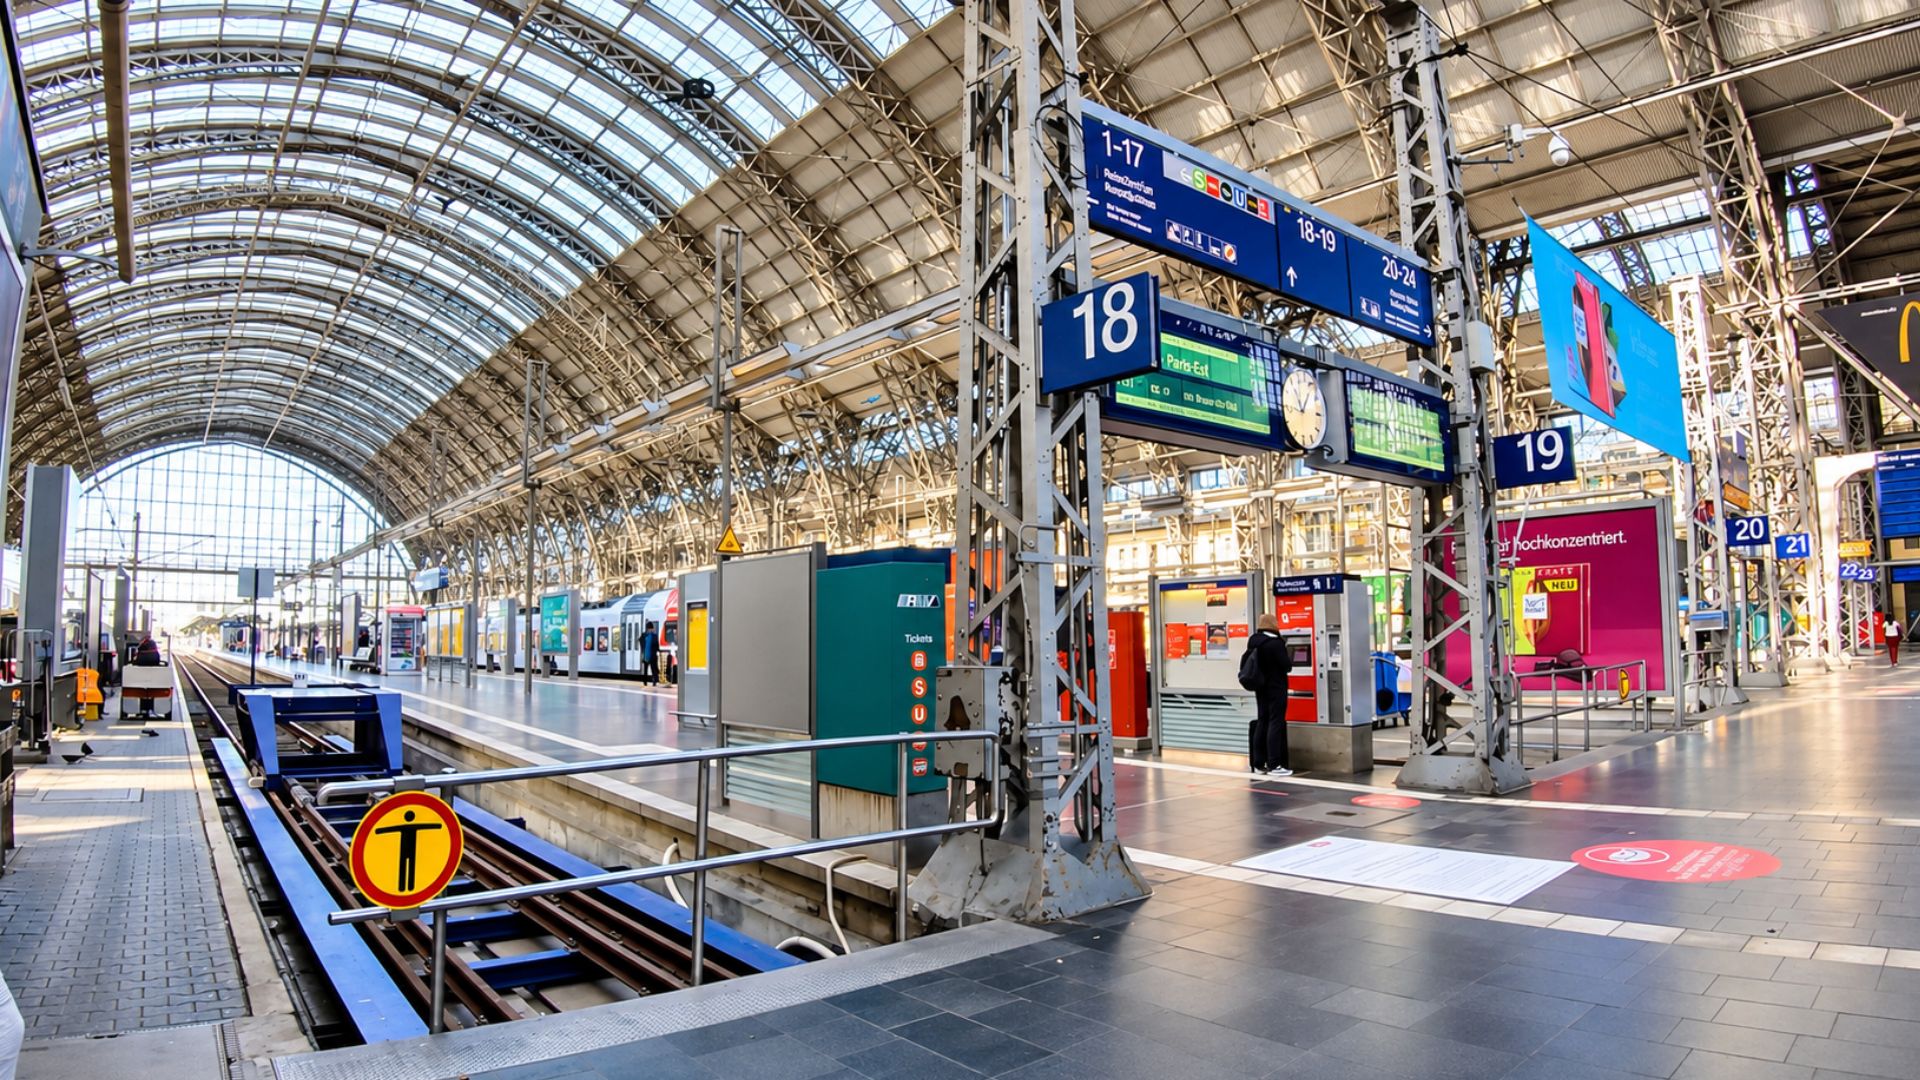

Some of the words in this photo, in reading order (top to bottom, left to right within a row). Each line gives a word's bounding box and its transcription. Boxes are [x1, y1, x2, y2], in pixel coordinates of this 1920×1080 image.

[1102, 129, 1144, 168] 1-17
[1193, 170, 1205, 189] S
[1235, 188, 1244, 207] U
[1296, 217, 1336, 252] 18-19
[1382, 255, 1417, 289] 20-24
[1072, 281, 1138, 361] 18
[1166, 353, 1209, 378] Paris-Est
[1516, 429, 1564, 473] 19
[1735, 517, 1764, 541] 20
[1514, 530, 1627, 551] hochkonzentriert.
[1786, 535, 1807, 555] 21
[1841, 562, 1858, 576] 22
[1858, 567, 1873, 580] 23
[1552, 580, 1575, 590] NEU
[904, 633, 933, 644] Tickets
[915, 680, 924, 695] S
[915, 708, 924, 722] U
